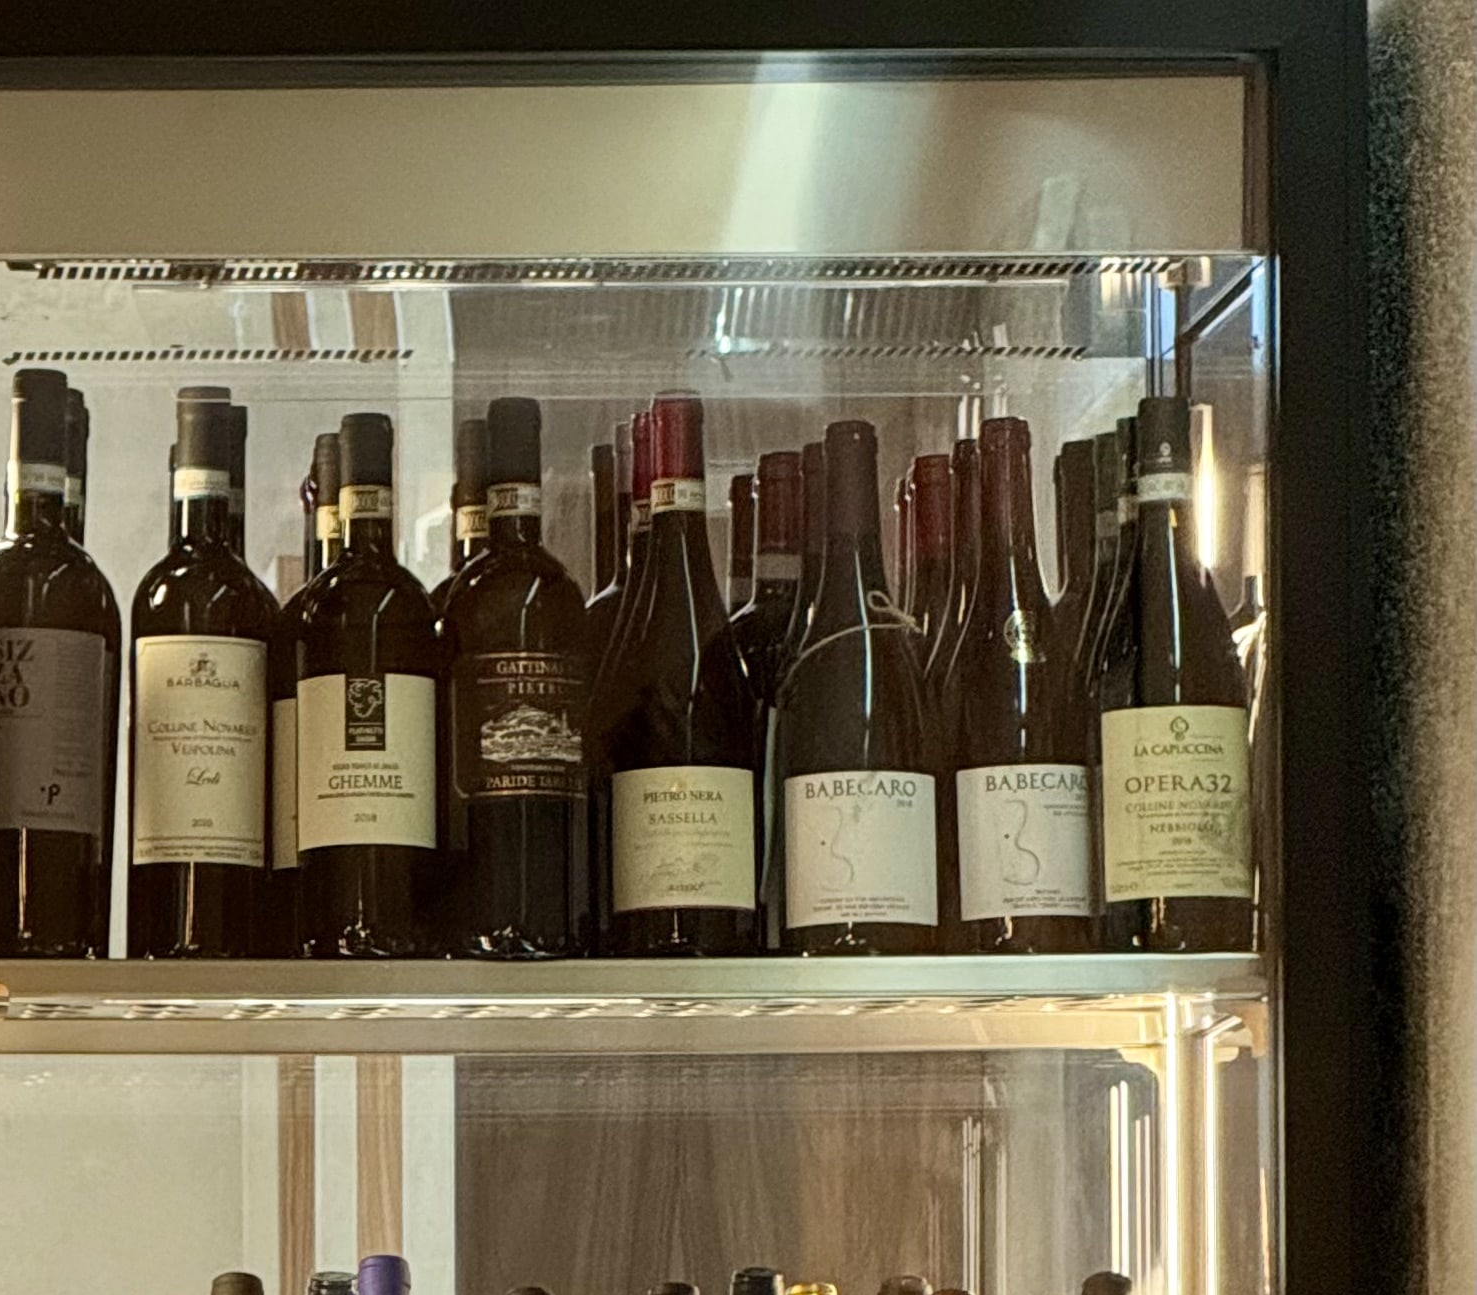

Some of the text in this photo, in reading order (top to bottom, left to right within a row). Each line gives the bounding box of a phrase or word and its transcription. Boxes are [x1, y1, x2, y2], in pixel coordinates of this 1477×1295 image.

[166, 677, 241, 689] BARBAGLIA
[171, 743, 236, 757] VESPOLINA
[1133, 744, 1149, 757] LA
[328, 774, 403, 790] GHEMME
[1124, 773, 1232, 794] OPERA32
[648, 812, 718, 825] SASSELLA
